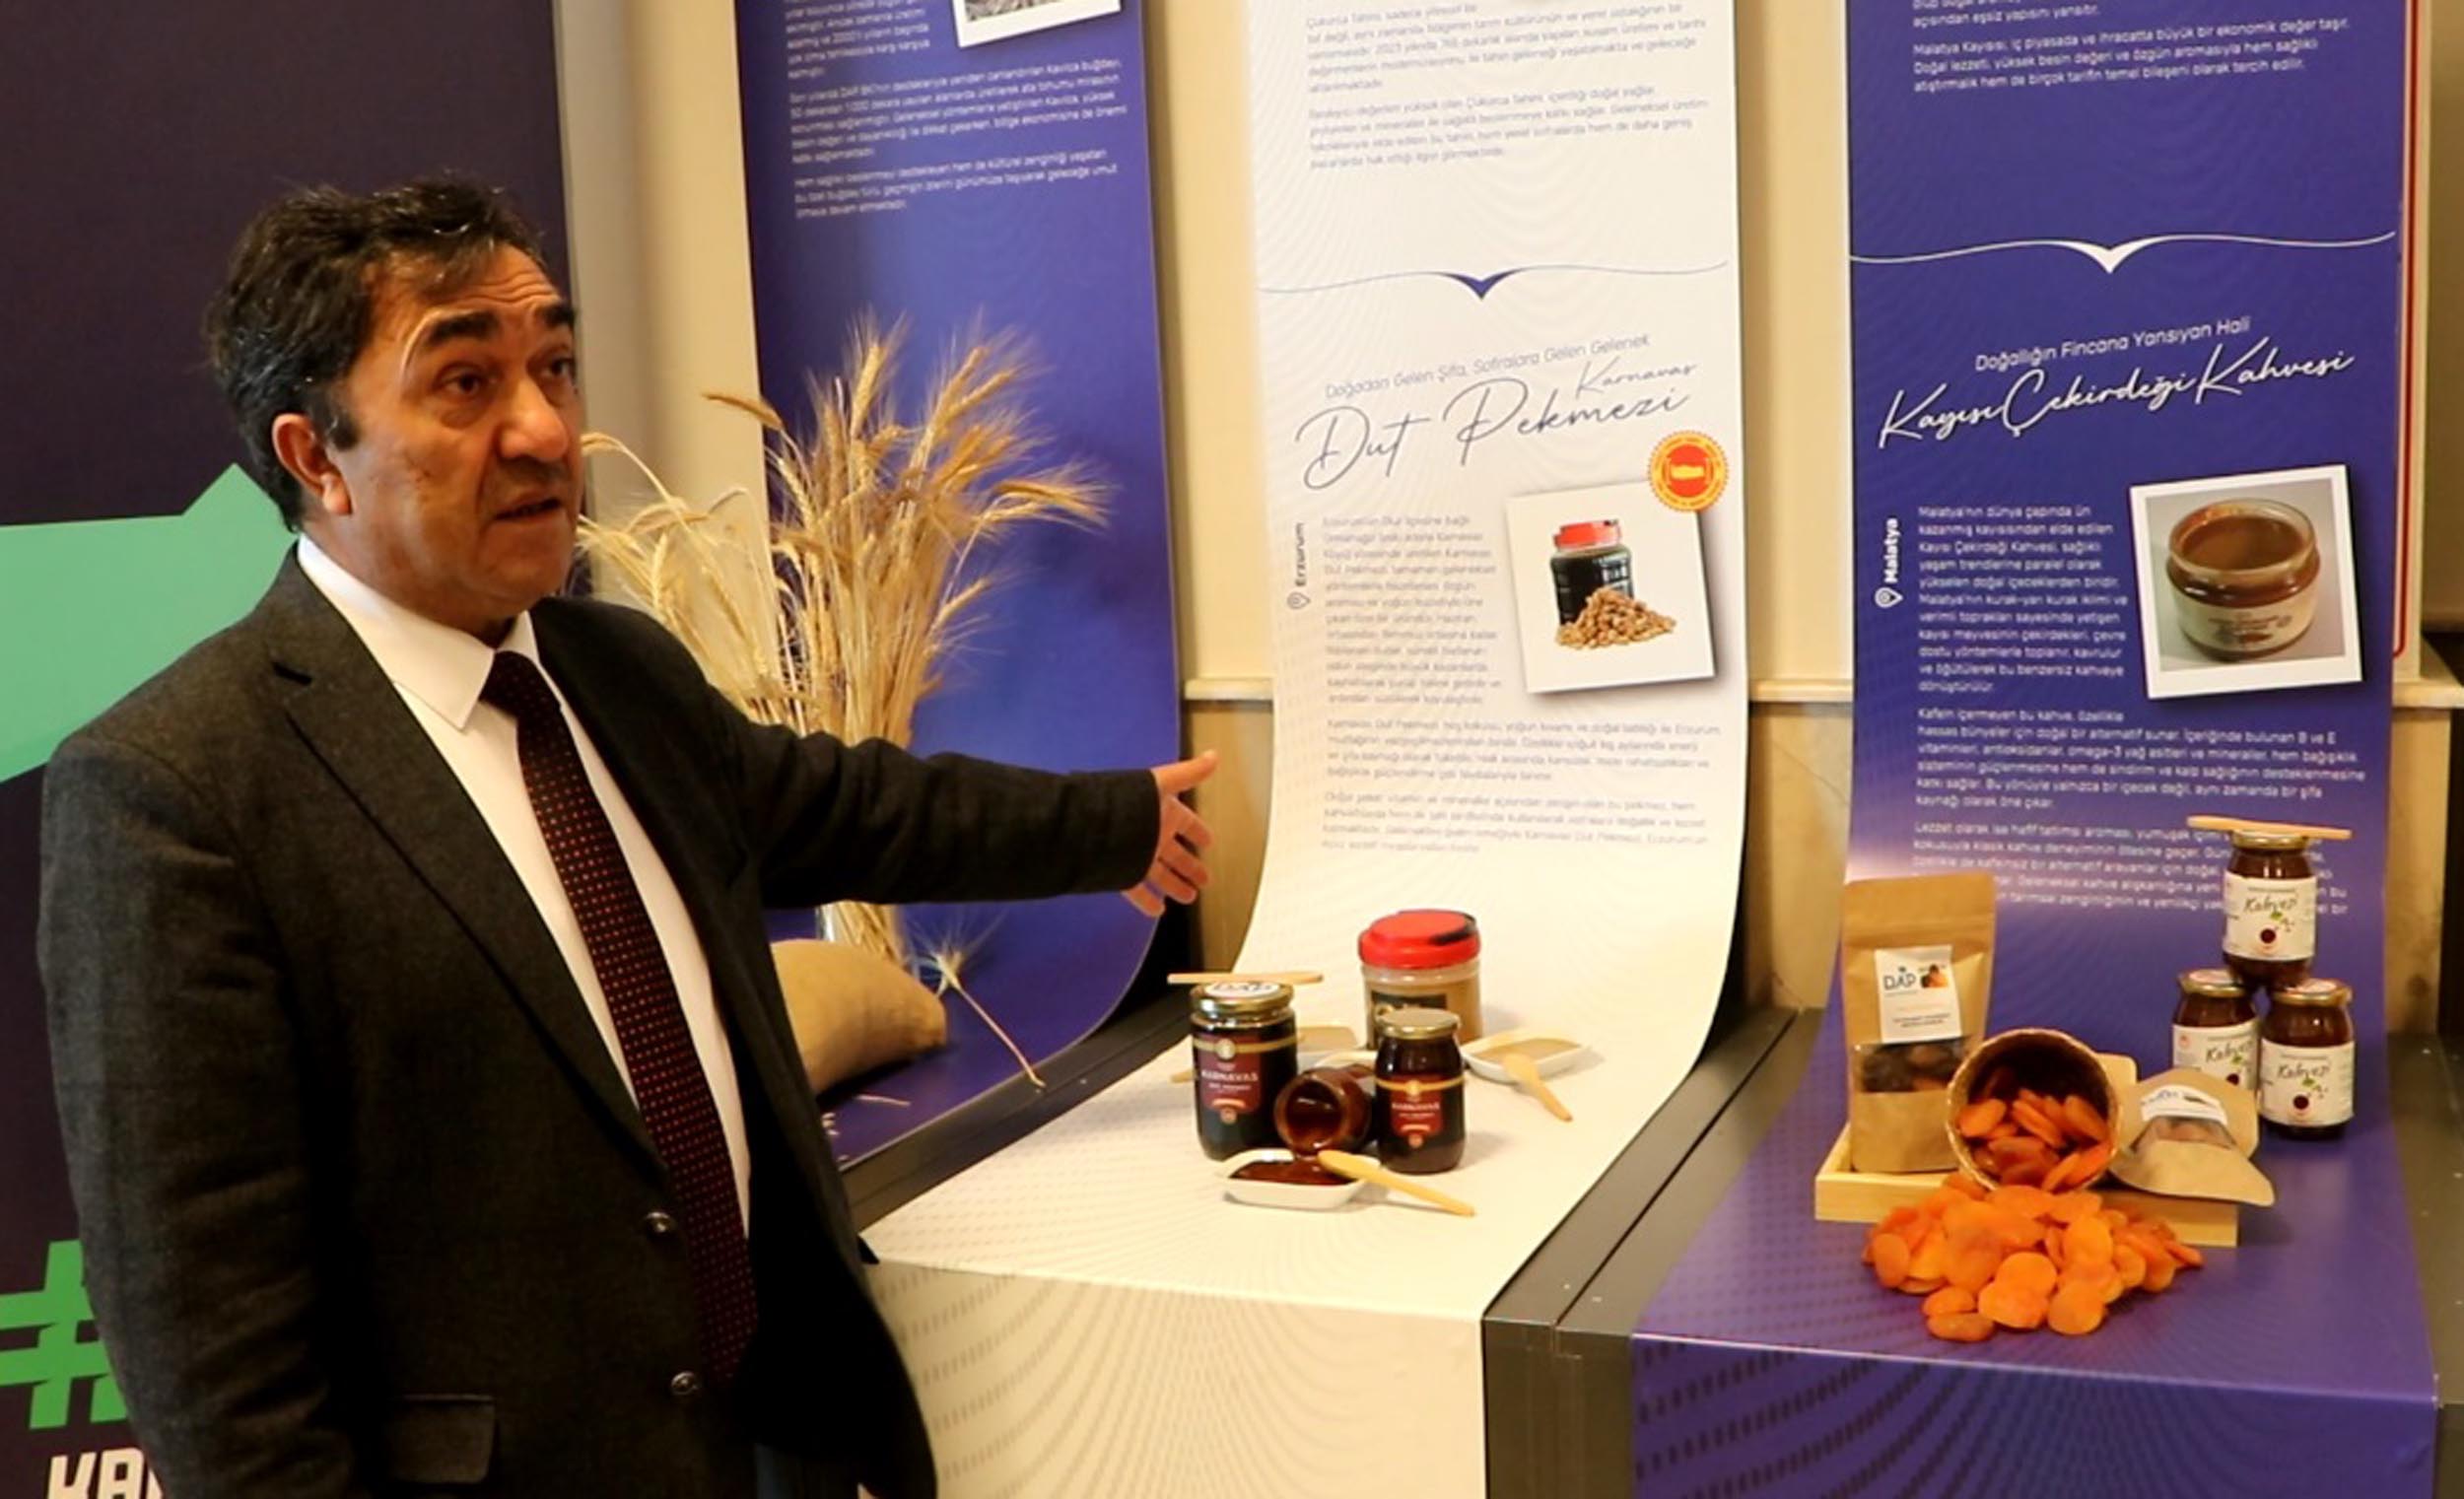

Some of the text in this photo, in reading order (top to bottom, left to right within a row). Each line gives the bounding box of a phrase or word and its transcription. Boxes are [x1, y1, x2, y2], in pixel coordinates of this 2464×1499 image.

[1324, 374, 1390, 399] Doğadan
[1393, 368, 1435, 387] Gelen
[1543, 345, 1587, 364] Gelen
[1590, 333, 1652, 355] Gelenek
[1974, 314, 2252, 374] Doğallığın Fincana Yansıyan Hali
[1575, 356, 1699, 400] Karnavas
[1879, 336, 2356, 448] Kayısı Çekirdeği Kahvesi
[1294, 376, 1691, 490] Dut Pekmezi
[1293, 521, 1308, 588] Erzurum
[1883, 517, 1901, 583] Malatya
[1883, 972, 1917, 990] DAP
[47, 1447, 165, 1499] KA
